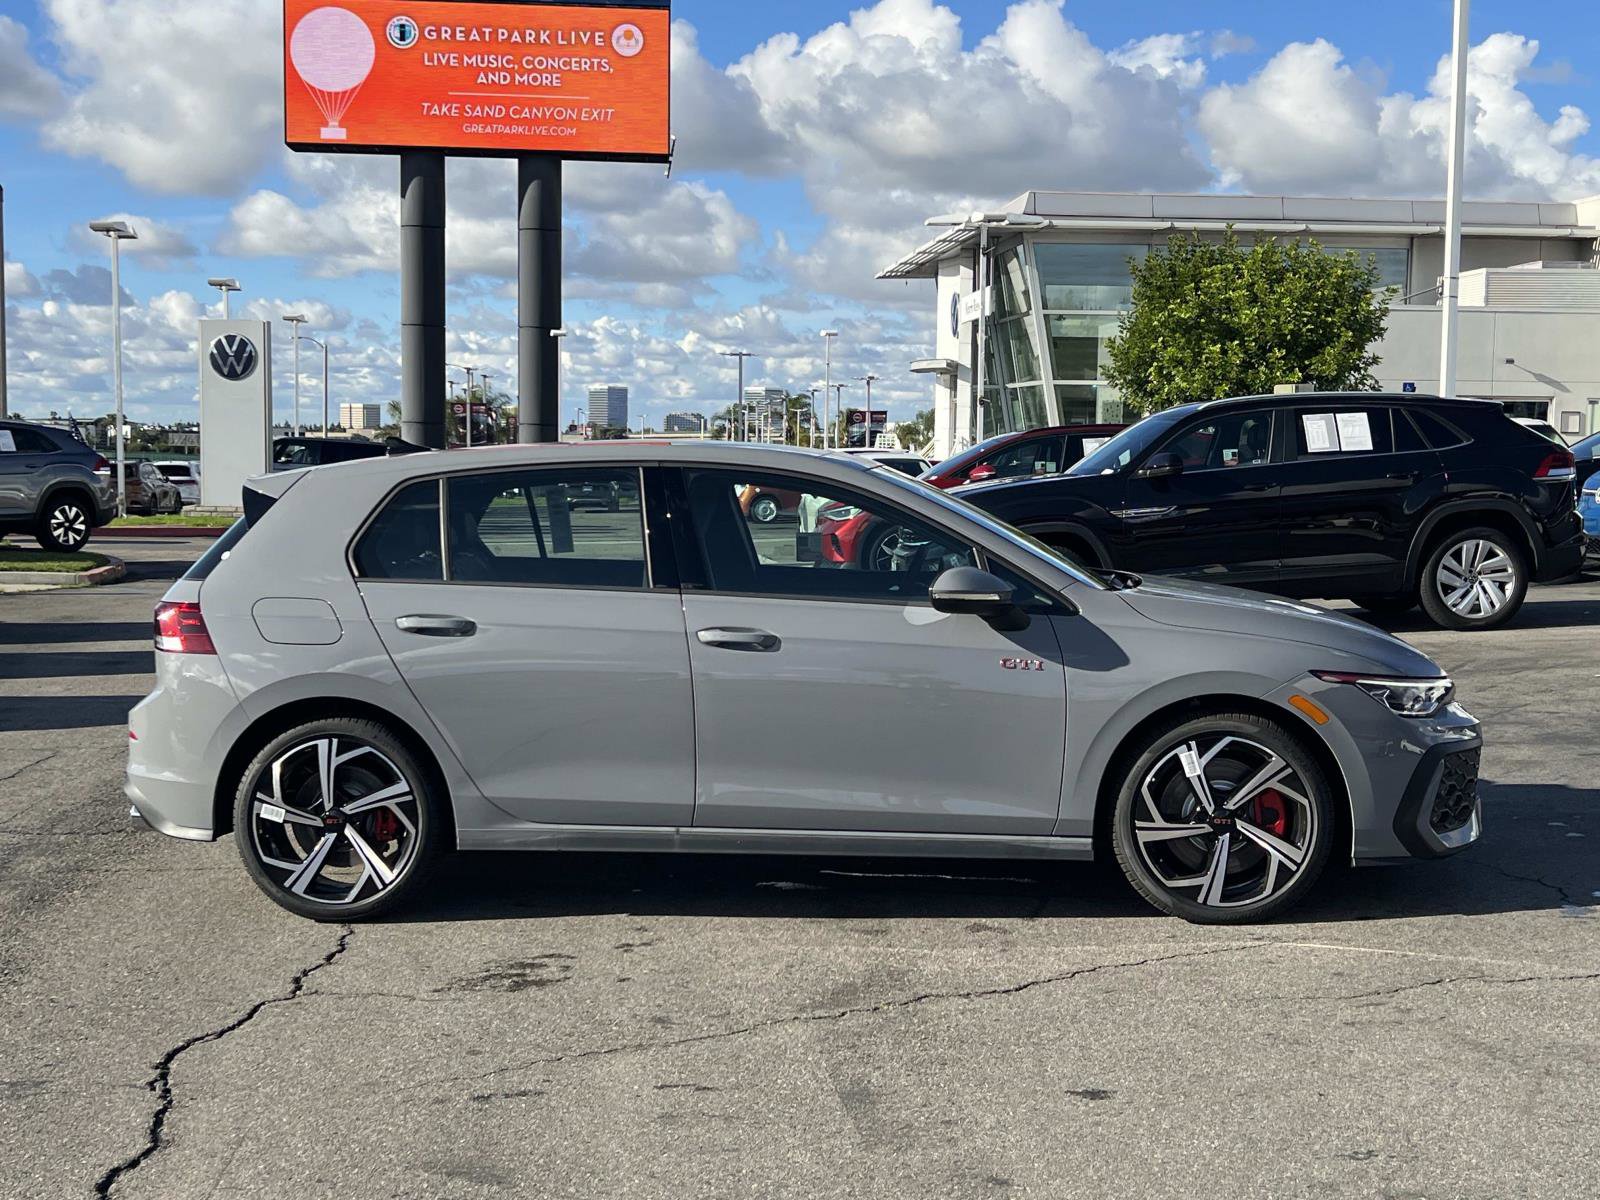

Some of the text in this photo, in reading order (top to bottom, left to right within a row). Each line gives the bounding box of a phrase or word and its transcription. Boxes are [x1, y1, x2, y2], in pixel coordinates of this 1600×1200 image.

[424, 26, 493, 42] GREAT
[498, 28, 551, 44] PARK
[557, 30, 605, 46] LIVE
[423, 52, 614, 74] LIVE MUSIC, CONCERTS,
[476, 71, 562, 87] AND MORE
[421, 102, 615, 122] TAKE SAND CANYON EXIT
[462, 123, 577, 136] GREATPARKLIVE.COM
[210, 334, 256, 379] VW
[1000, 658, 1044, 671] GTI
